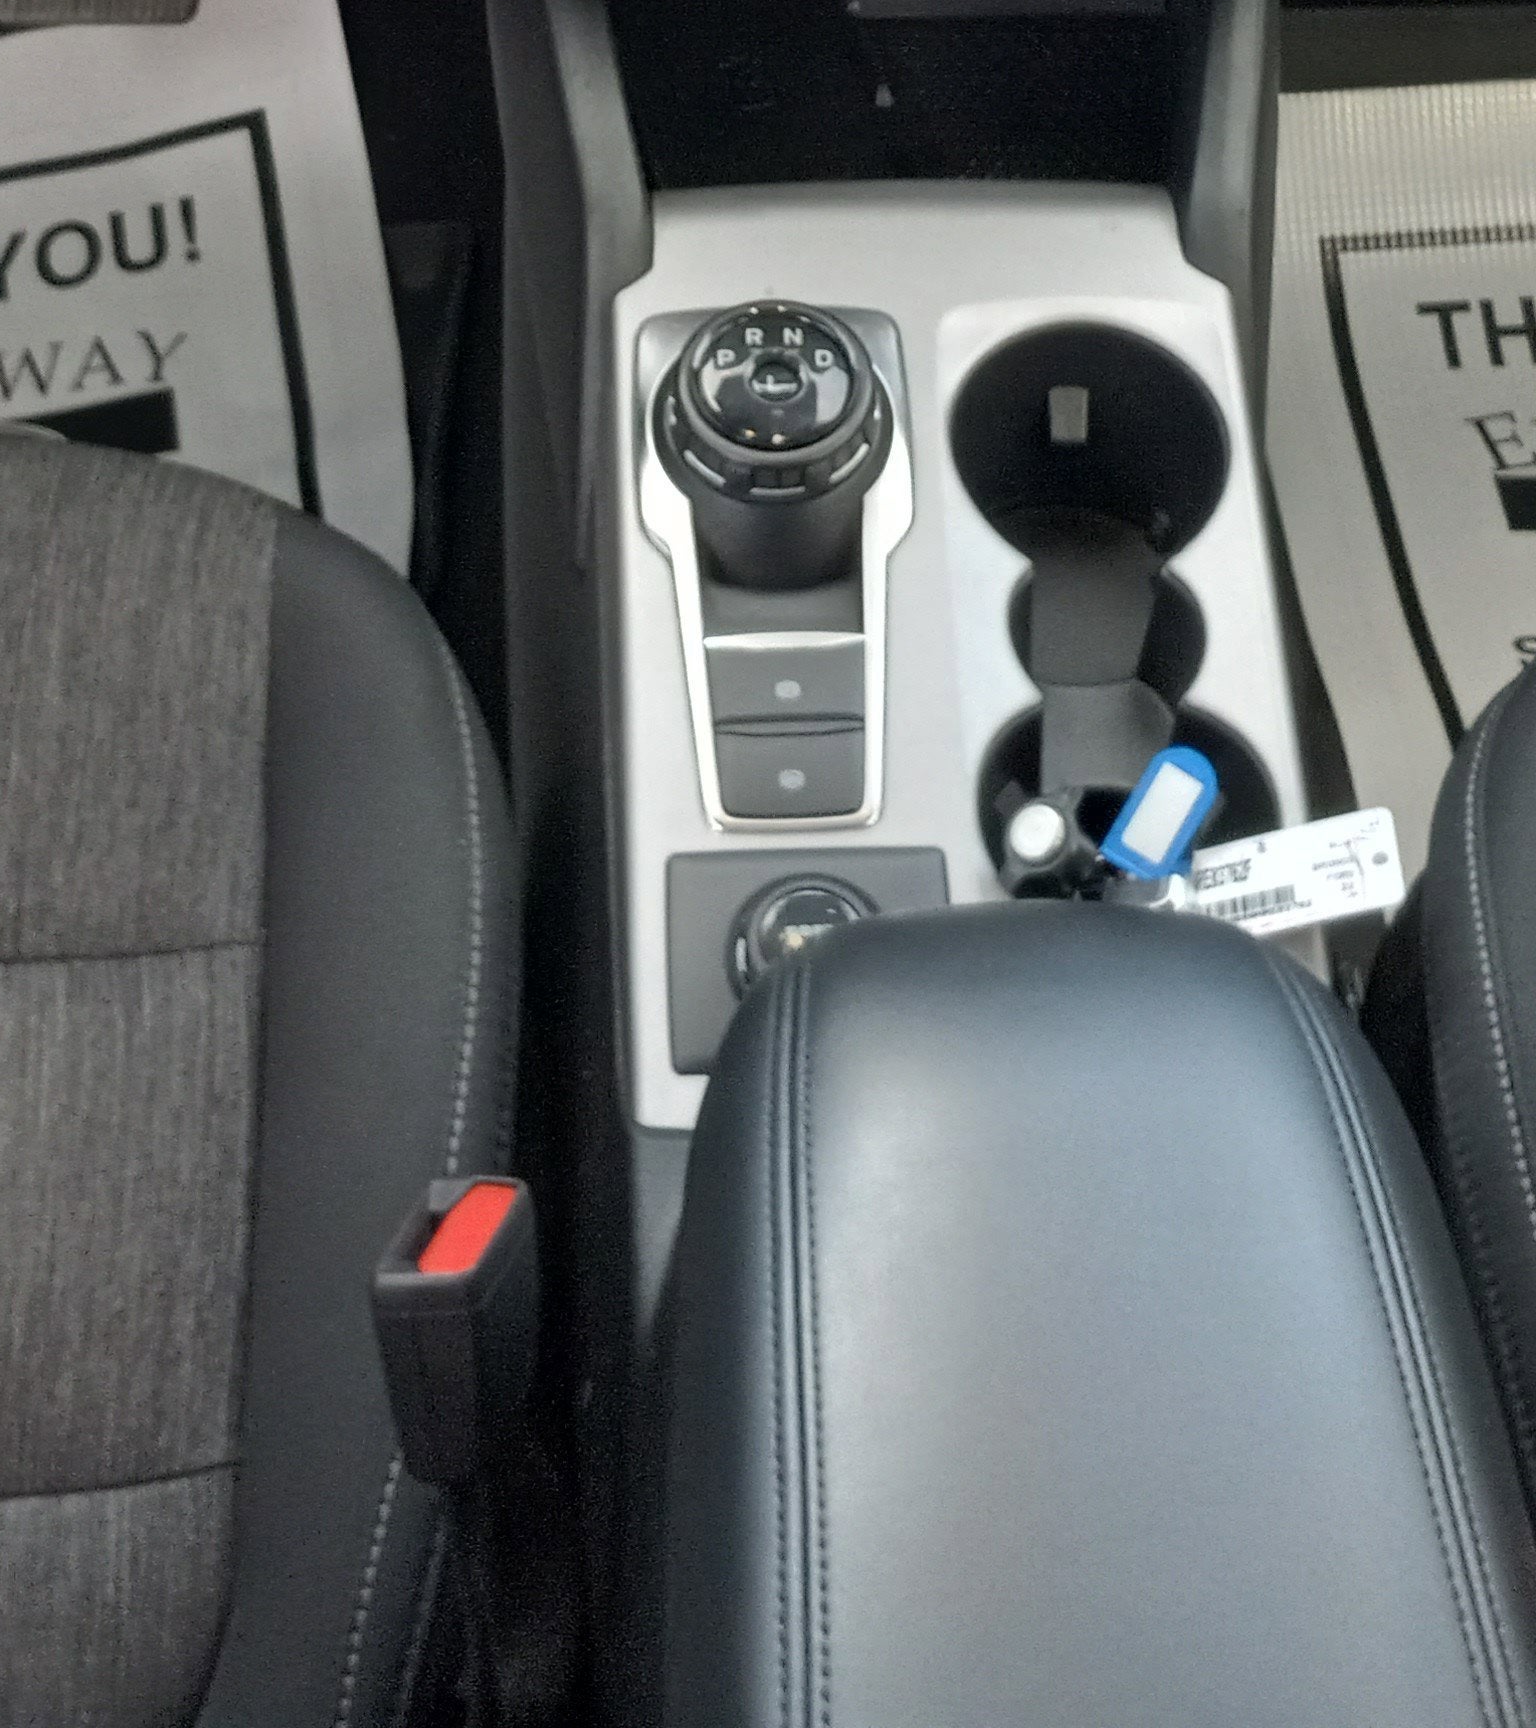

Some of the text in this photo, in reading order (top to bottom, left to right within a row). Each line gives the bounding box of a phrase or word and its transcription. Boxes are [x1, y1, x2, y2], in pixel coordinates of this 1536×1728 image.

[745, 327, 805, 346] R N
[716, 348, 736, 367] P
[814, 349, 834, 368] D
